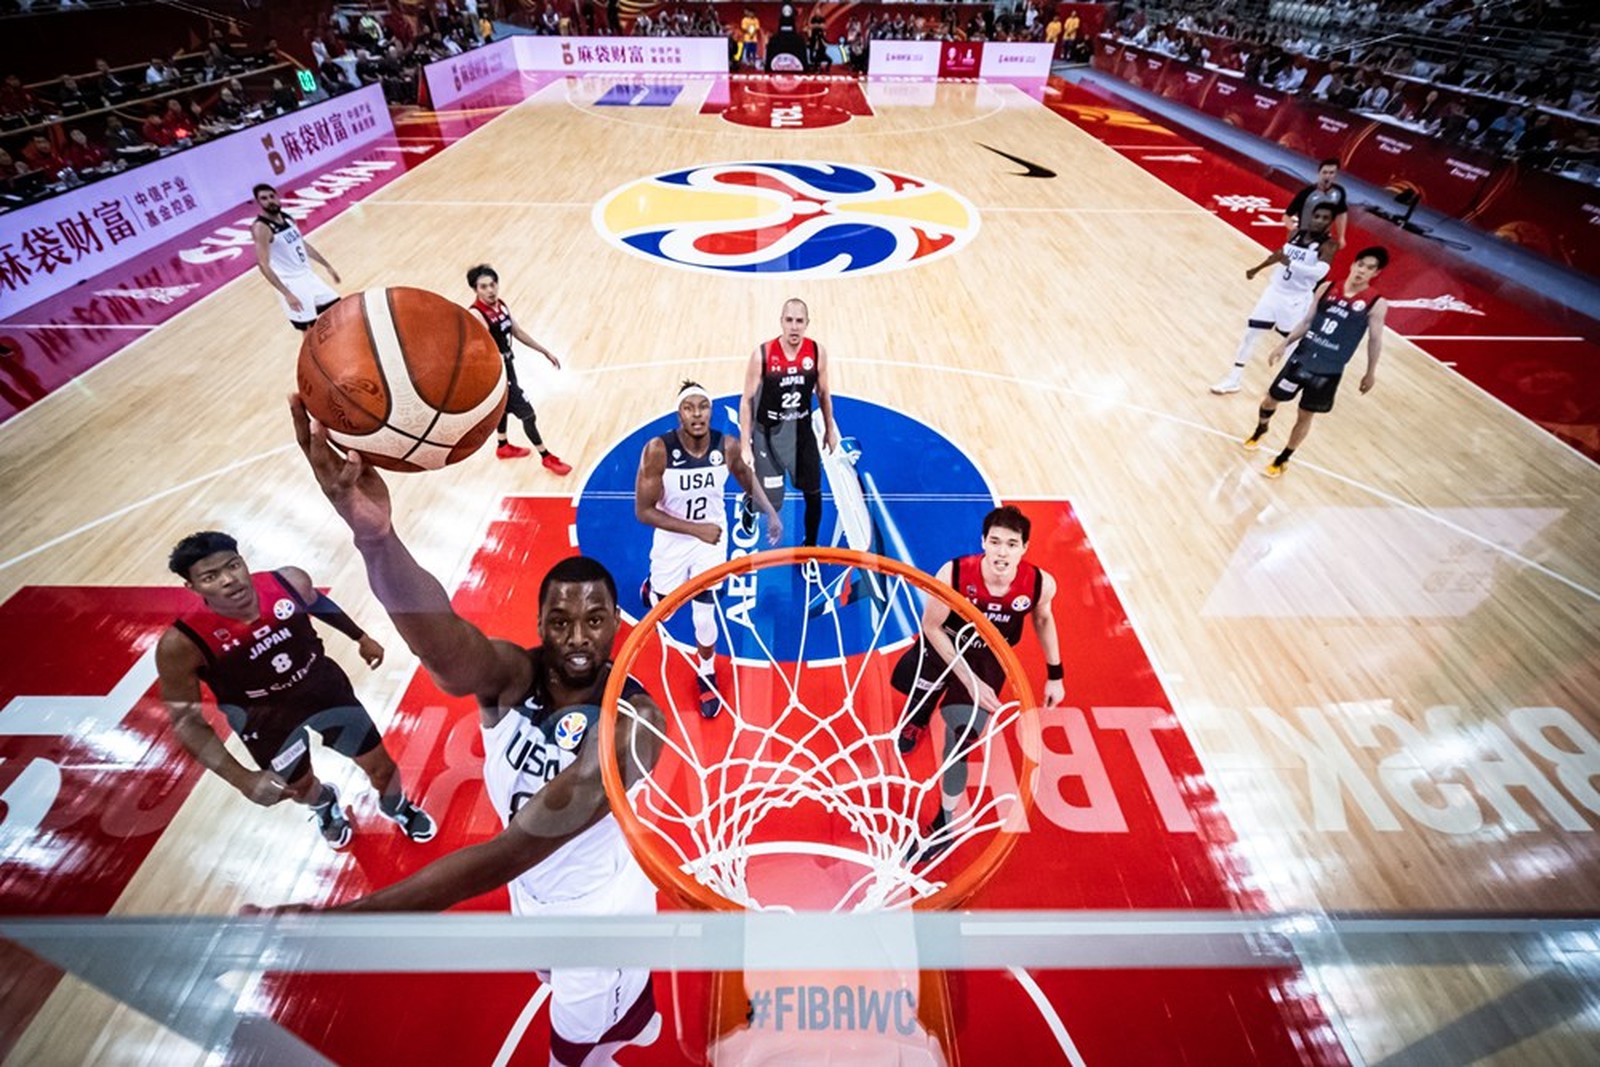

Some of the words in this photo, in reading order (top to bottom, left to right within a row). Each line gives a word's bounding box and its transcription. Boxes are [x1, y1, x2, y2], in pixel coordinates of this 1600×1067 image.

[577, 45, 644, 64] 麻袋财富
[281, 112, 349, 163] 麻袋财富
[135, 176, 188, 207] 中信产业
[145, 194, 197, 228] 基金控股
[1287, 248, 1307, 262] USA
[1326, 306, 1350, 319] JAPAN
[779, 375, 805, 387] JAPAN
[781, 391, 802, 409] 22
[680, 472, 715, 491] USA
[686, 497, 707, 520] 12
[249, 627, 292, 660] JAPAN
[271, 652, 293, 674] 8
[506, 731, 561, 783] USA
[749, 985, 917, 1036] #FIBAWC
